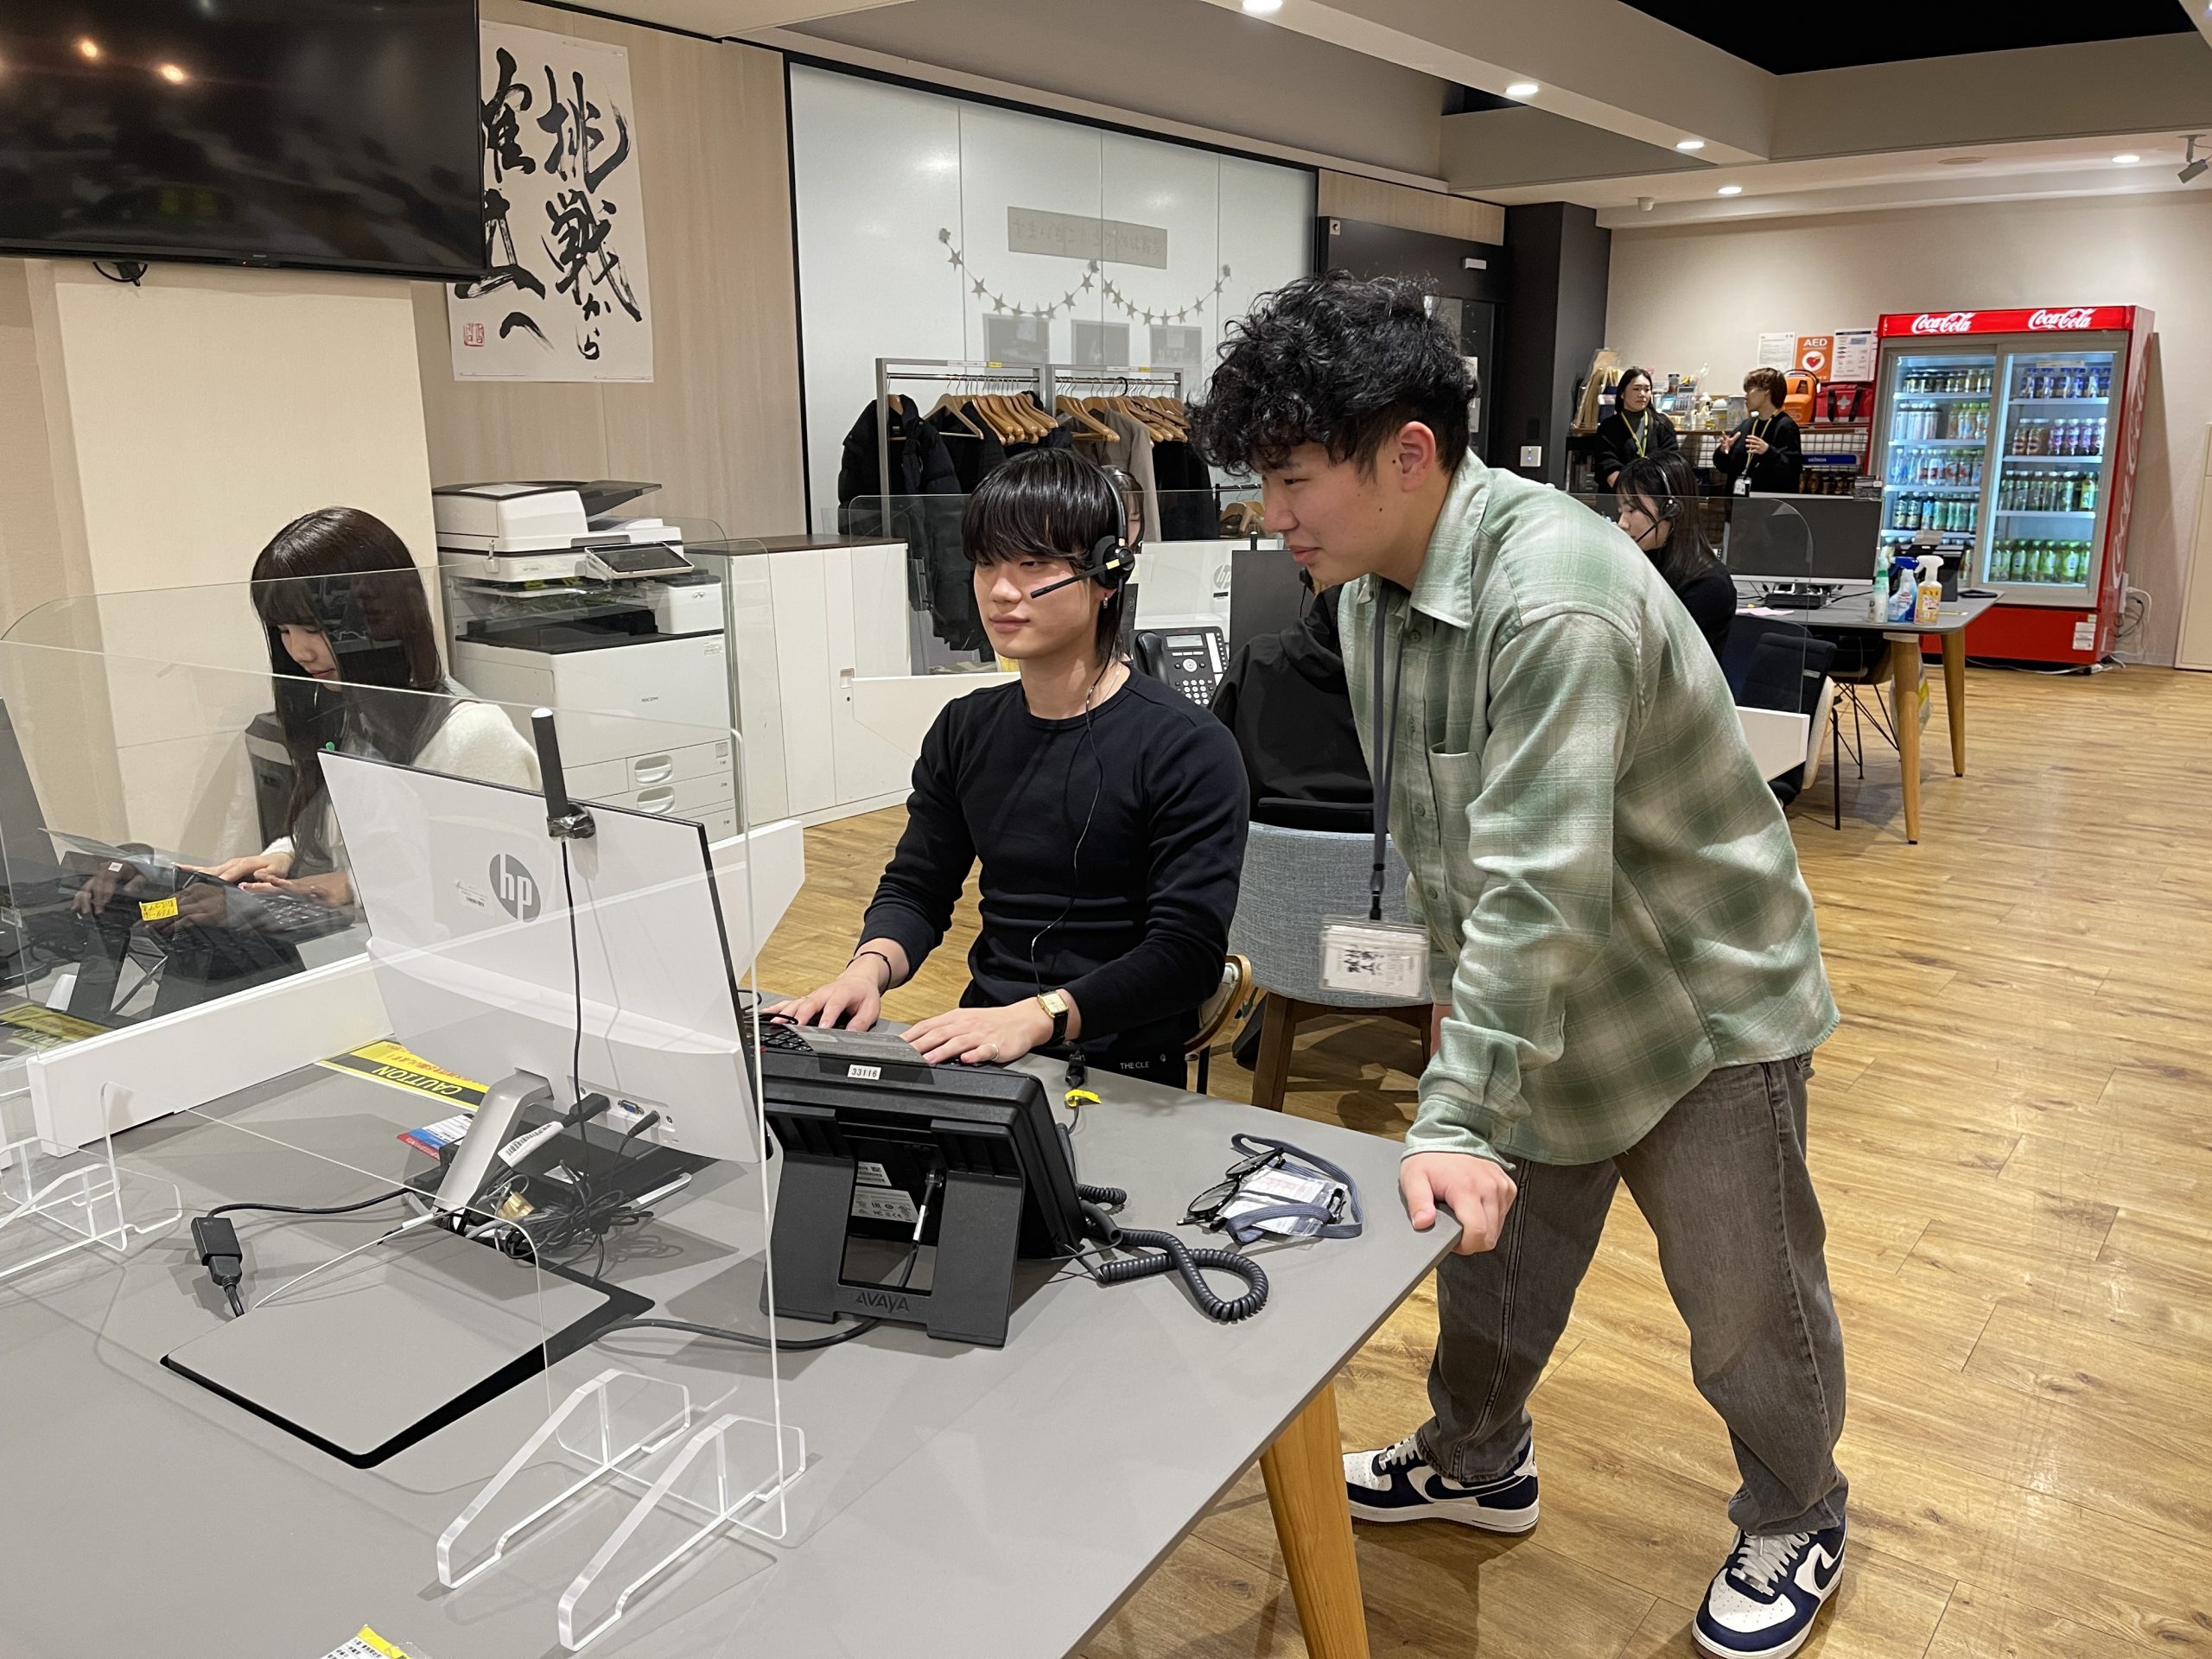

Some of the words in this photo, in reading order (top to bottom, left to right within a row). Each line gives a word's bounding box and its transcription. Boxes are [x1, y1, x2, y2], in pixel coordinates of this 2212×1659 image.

[537, 65, 642, 360] 挑戦から
[1803, 338, 1827, 347] AED
[499, 853, 533, 922] hp
[372, 1065, 463, 1095] CAUTION
[851, 1068, 878, 1077] 33116
[855, 1293, 910, 1313] AVAYA
